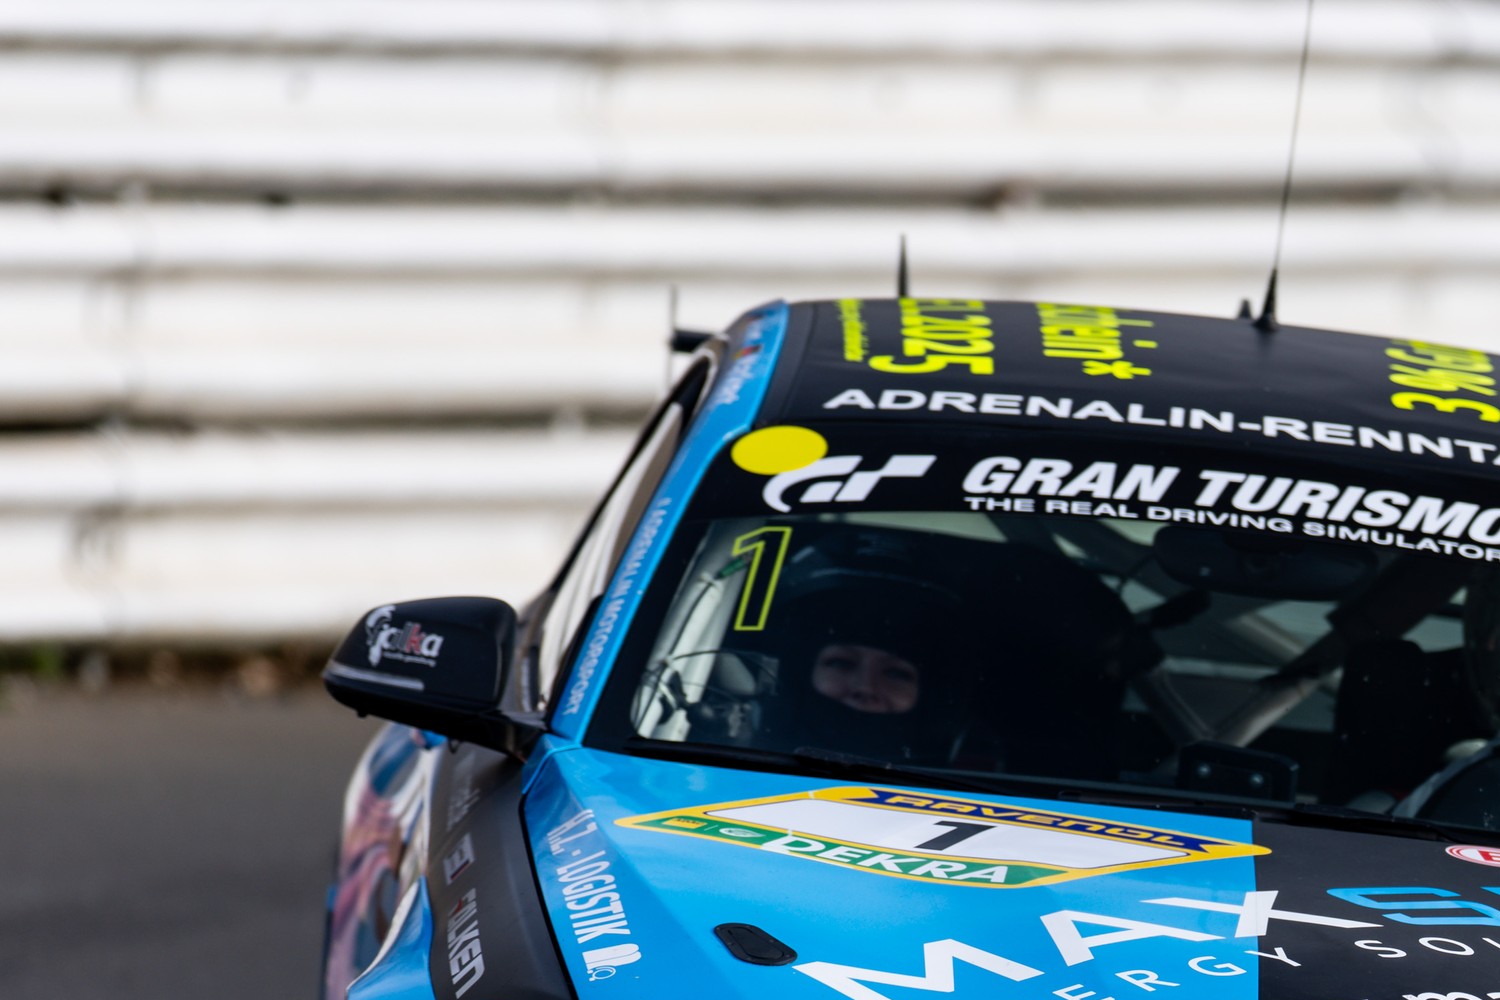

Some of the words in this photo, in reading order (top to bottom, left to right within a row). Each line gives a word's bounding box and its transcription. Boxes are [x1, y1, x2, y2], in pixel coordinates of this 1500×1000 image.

[868, 314, 995, 376] 2025
[963, 457, 1180, 503] GRAN
[965, 497, 1034, 514] THE
[1045, 500, 1140, 520] REAL
[1147, 506, 1294, 534] DRIVING
[733, 526, 792, 632] 1
[779, 836, 1010, 884] DEKRA
[916, 820, 998, 853] 1
[556, 850, 632, 945] LOGISTIK
